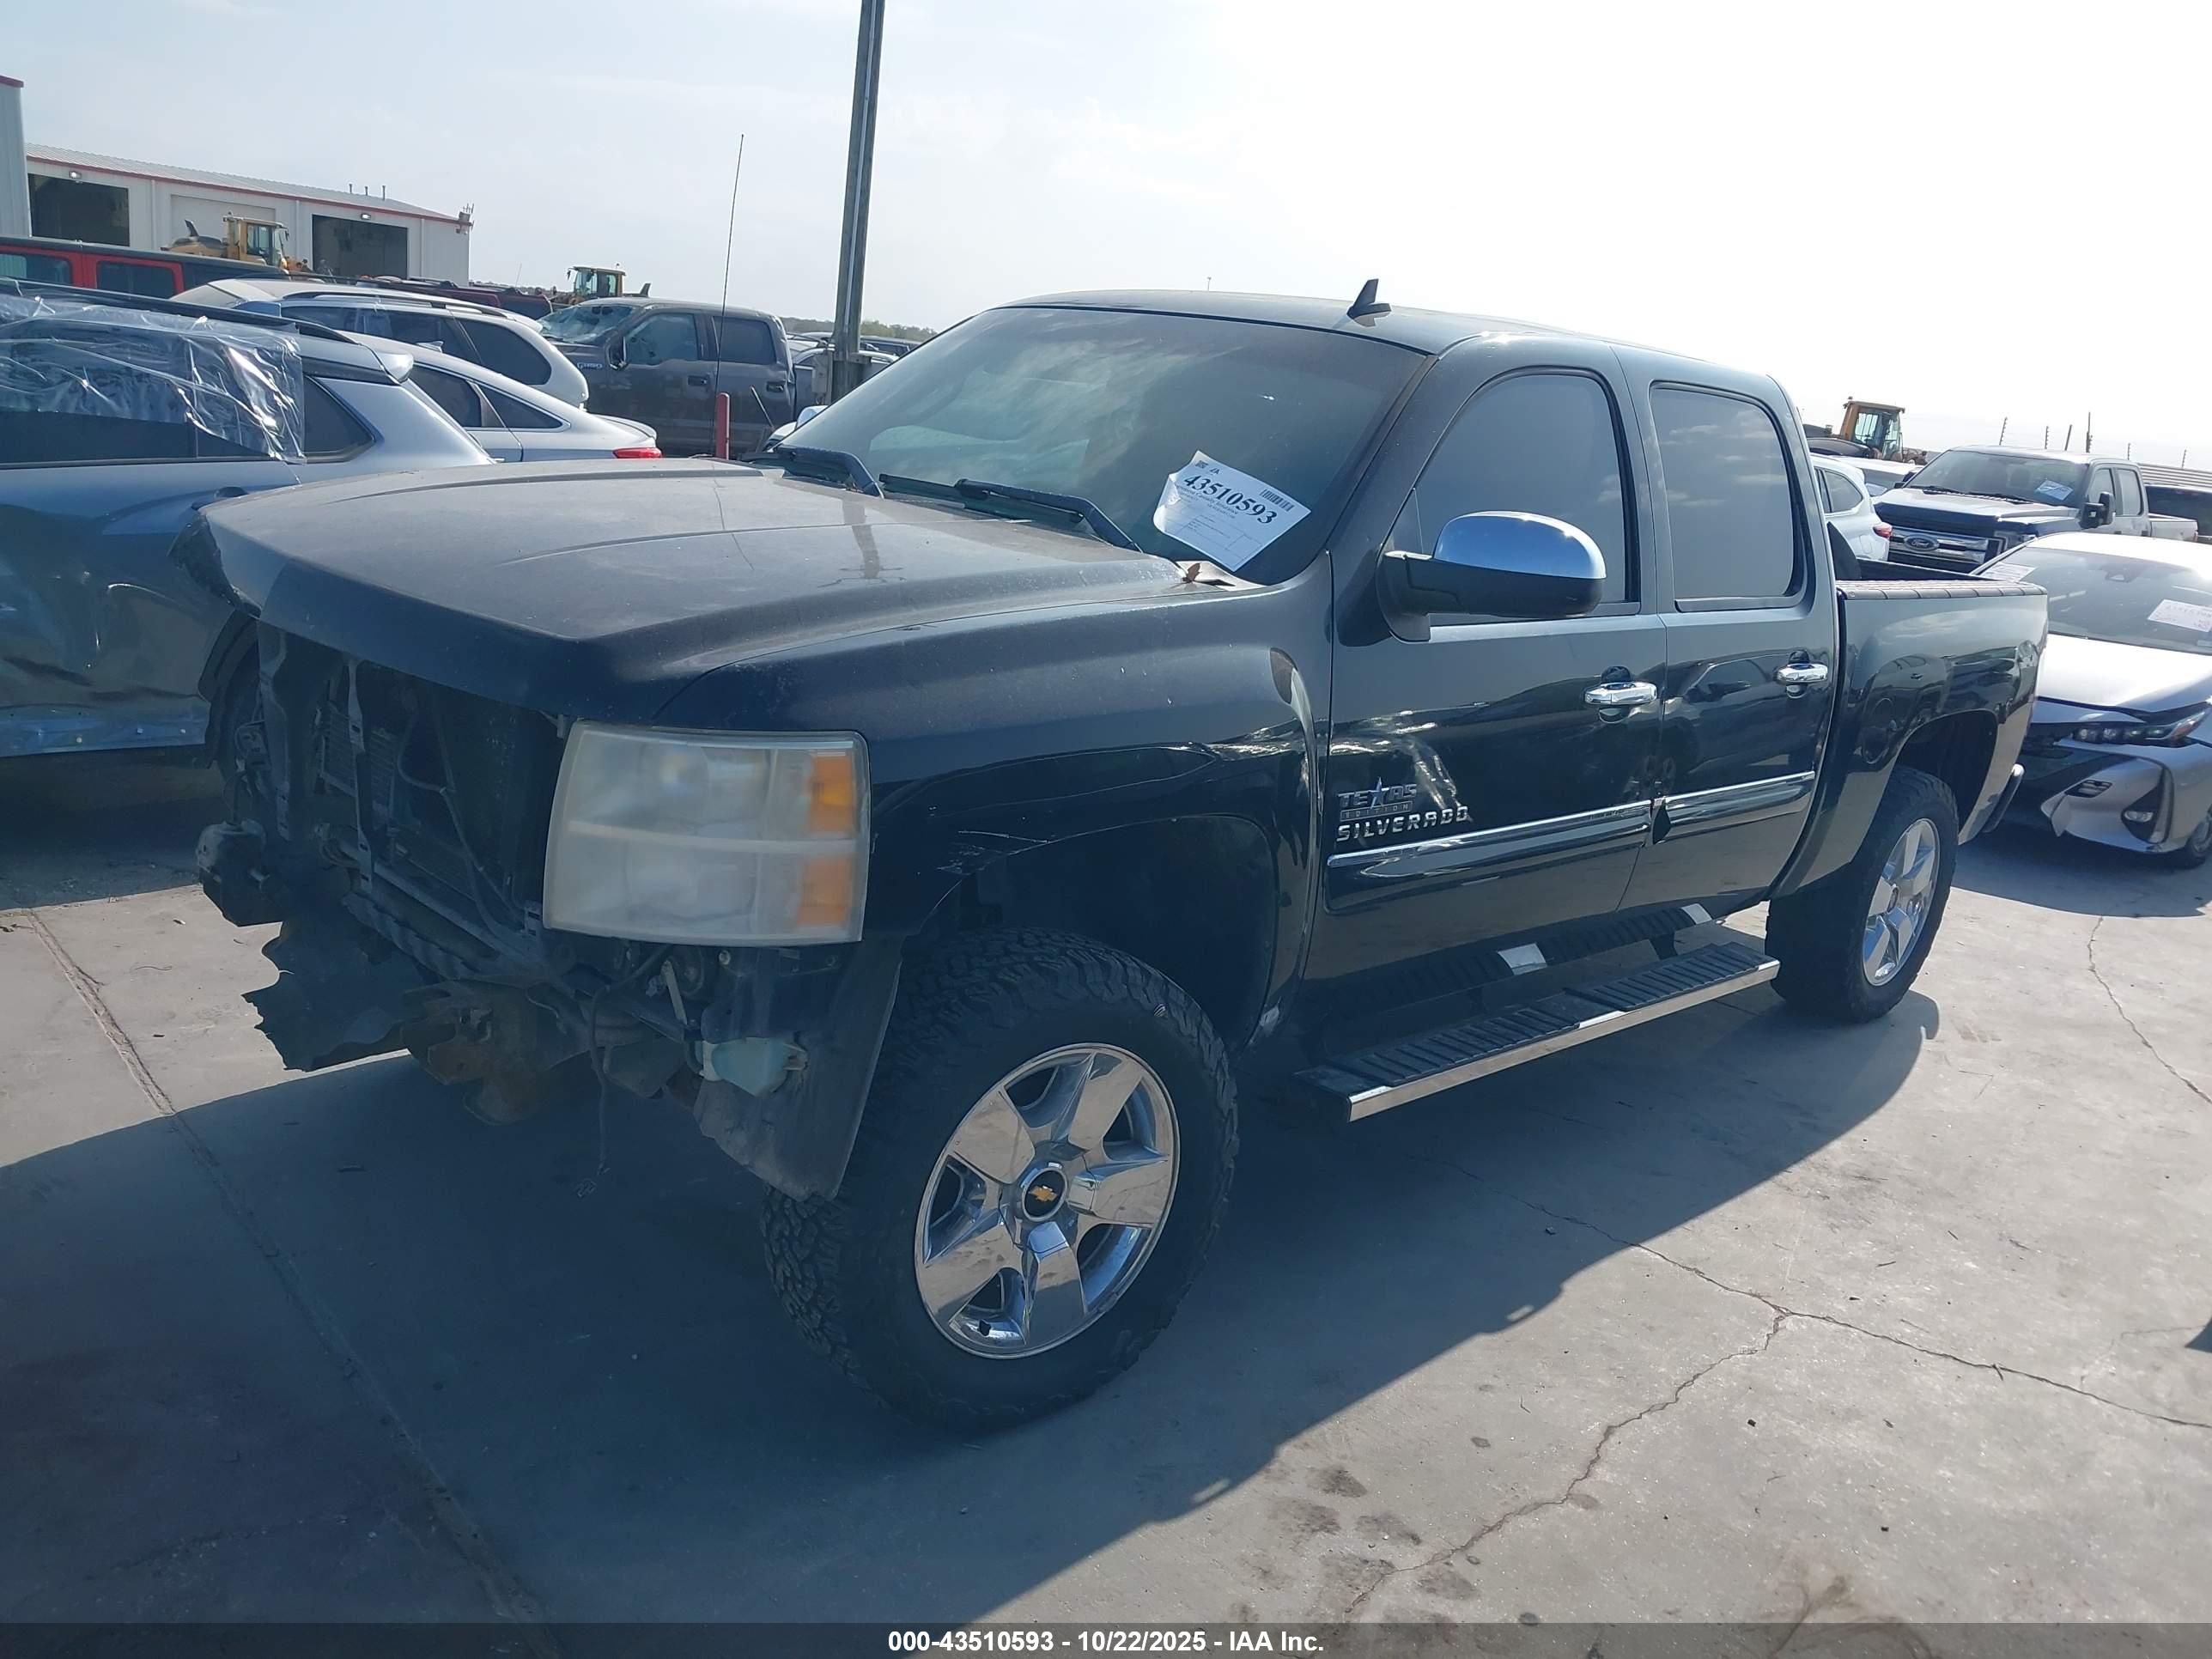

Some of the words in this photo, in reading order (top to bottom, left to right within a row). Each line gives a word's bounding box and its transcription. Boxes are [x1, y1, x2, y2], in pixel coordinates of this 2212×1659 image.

[1184, 475, 1278, 524] 43510593
[1337, 779, 1418, 808] TEXAS
[1335, 805, 1469, 842] SILVERADO
[1344, 804, 1409, 818] EDITION
